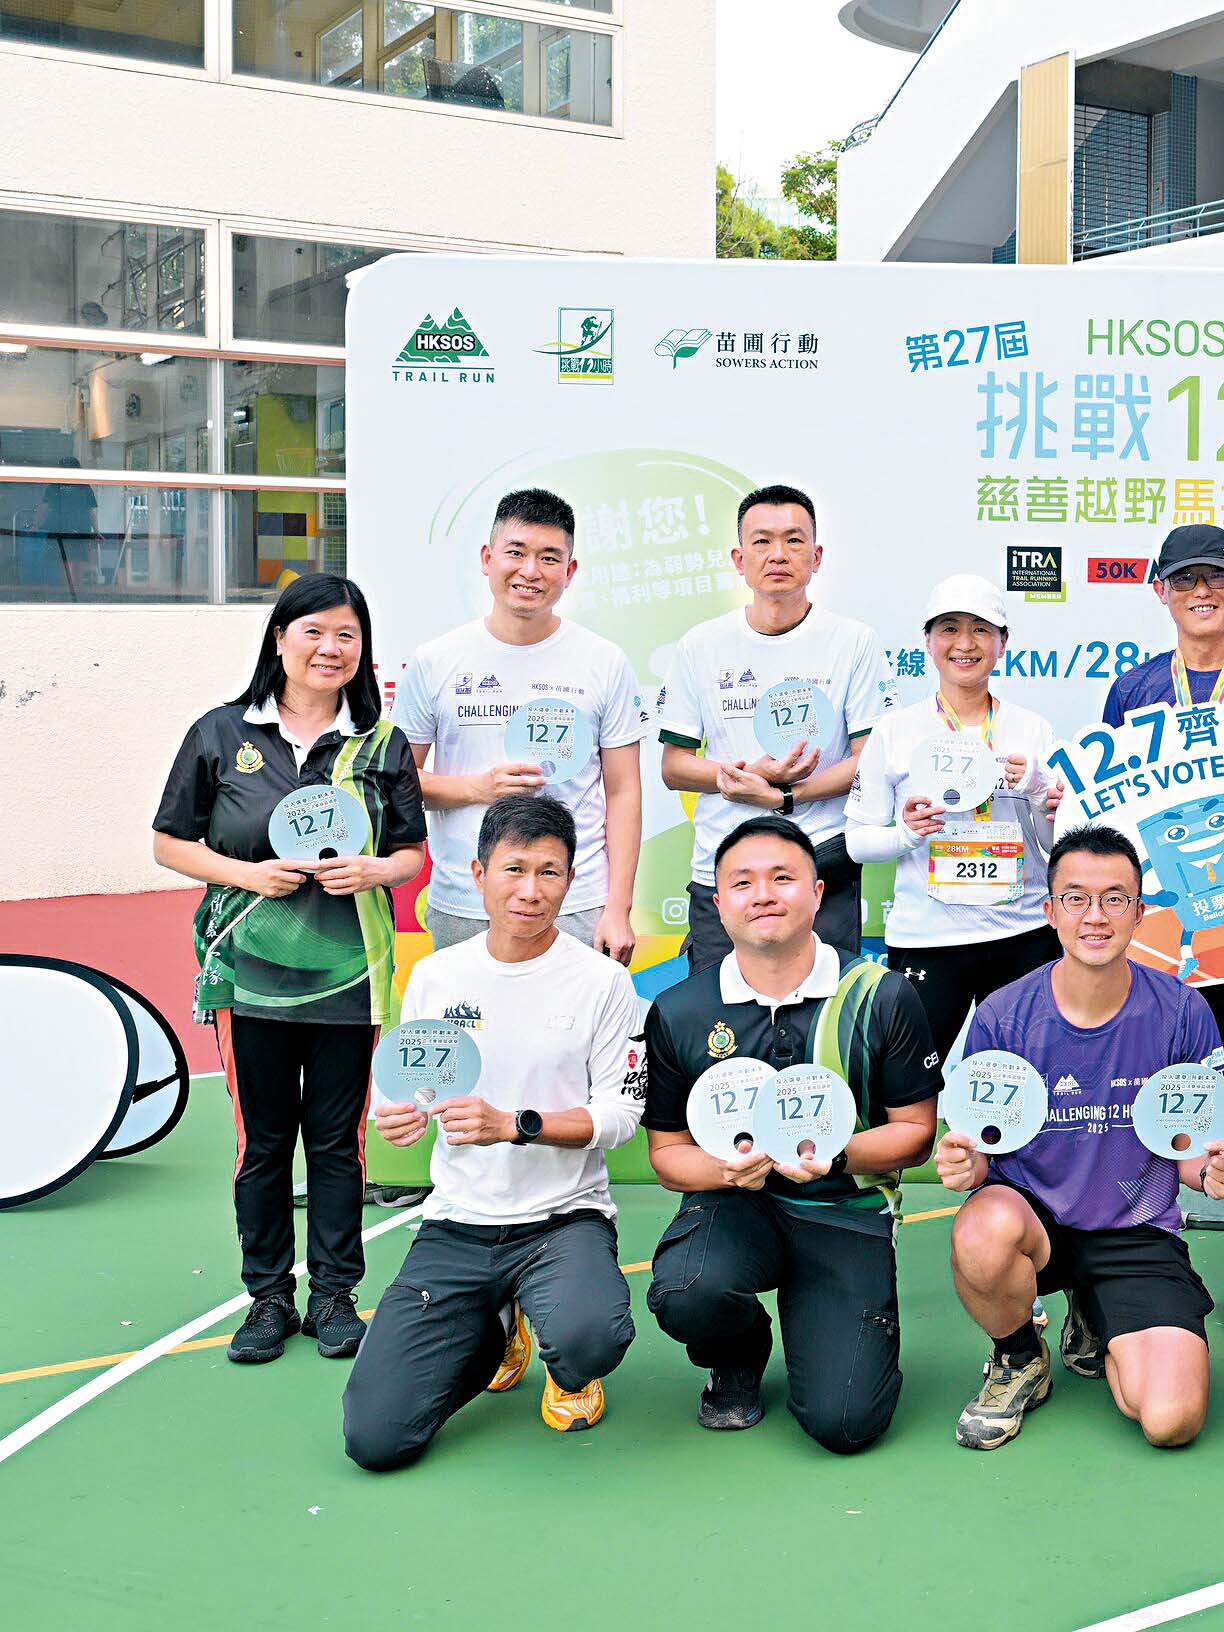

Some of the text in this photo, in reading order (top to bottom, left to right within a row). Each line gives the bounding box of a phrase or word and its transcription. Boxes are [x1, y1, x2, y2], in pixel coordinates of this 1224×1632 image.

[417, 335, 475, 350] HKSOS
[716, 332, 819, 354] 苗圃行動
[905, 320, 1029, 372] 第27屆
[560, 358, 612, 374] 挑戰12小時
[716, 358, 819, 370] SOWERS ACTION
[392, 372, 495, 383] TRAIL RUN
[1012, 550, 1057, 569] iTRA
[1095, 562, 1138, 579] 50K
[888, 648, 925, 677] 線
[457, 704, 520, 718] CHALLENGIN
[770, 700, 787, 708] 2025
[770, 707, 794, 727] 12
[526, 723, 549, 743] 12
[1047, 709, 1166, 795] 12.7
[931, 754, 953, 773] 12
[1080, 772, 1151, 820] LET'S
[287, 808, 307, 819] 2025
[288, 814, 318, 837] 12
[946, 845, 969, 853] 28KM
[956, 862, 998, 878] 2312
[398, 1047, 426, 1067] 12
[970, 1070, 992, 1079] 2025
[709, 1082, 730, 1091] 2025
[776, 1087, 797, 1097] 2025
[969, 1079, 995, 1104] 12
[1160, 1083, 1181, 1091] 2025
[710, 1090, 738, 1115] 12
[776, 1096, 803, 1121] 12
[1159, 1093, 1185, 1113] 12
[1046, 1104, 1106, 1122] ALLENGING
[1108, 1104, 1120, 1119] 12
[1087, 1122, 1109, 1134] 2025
